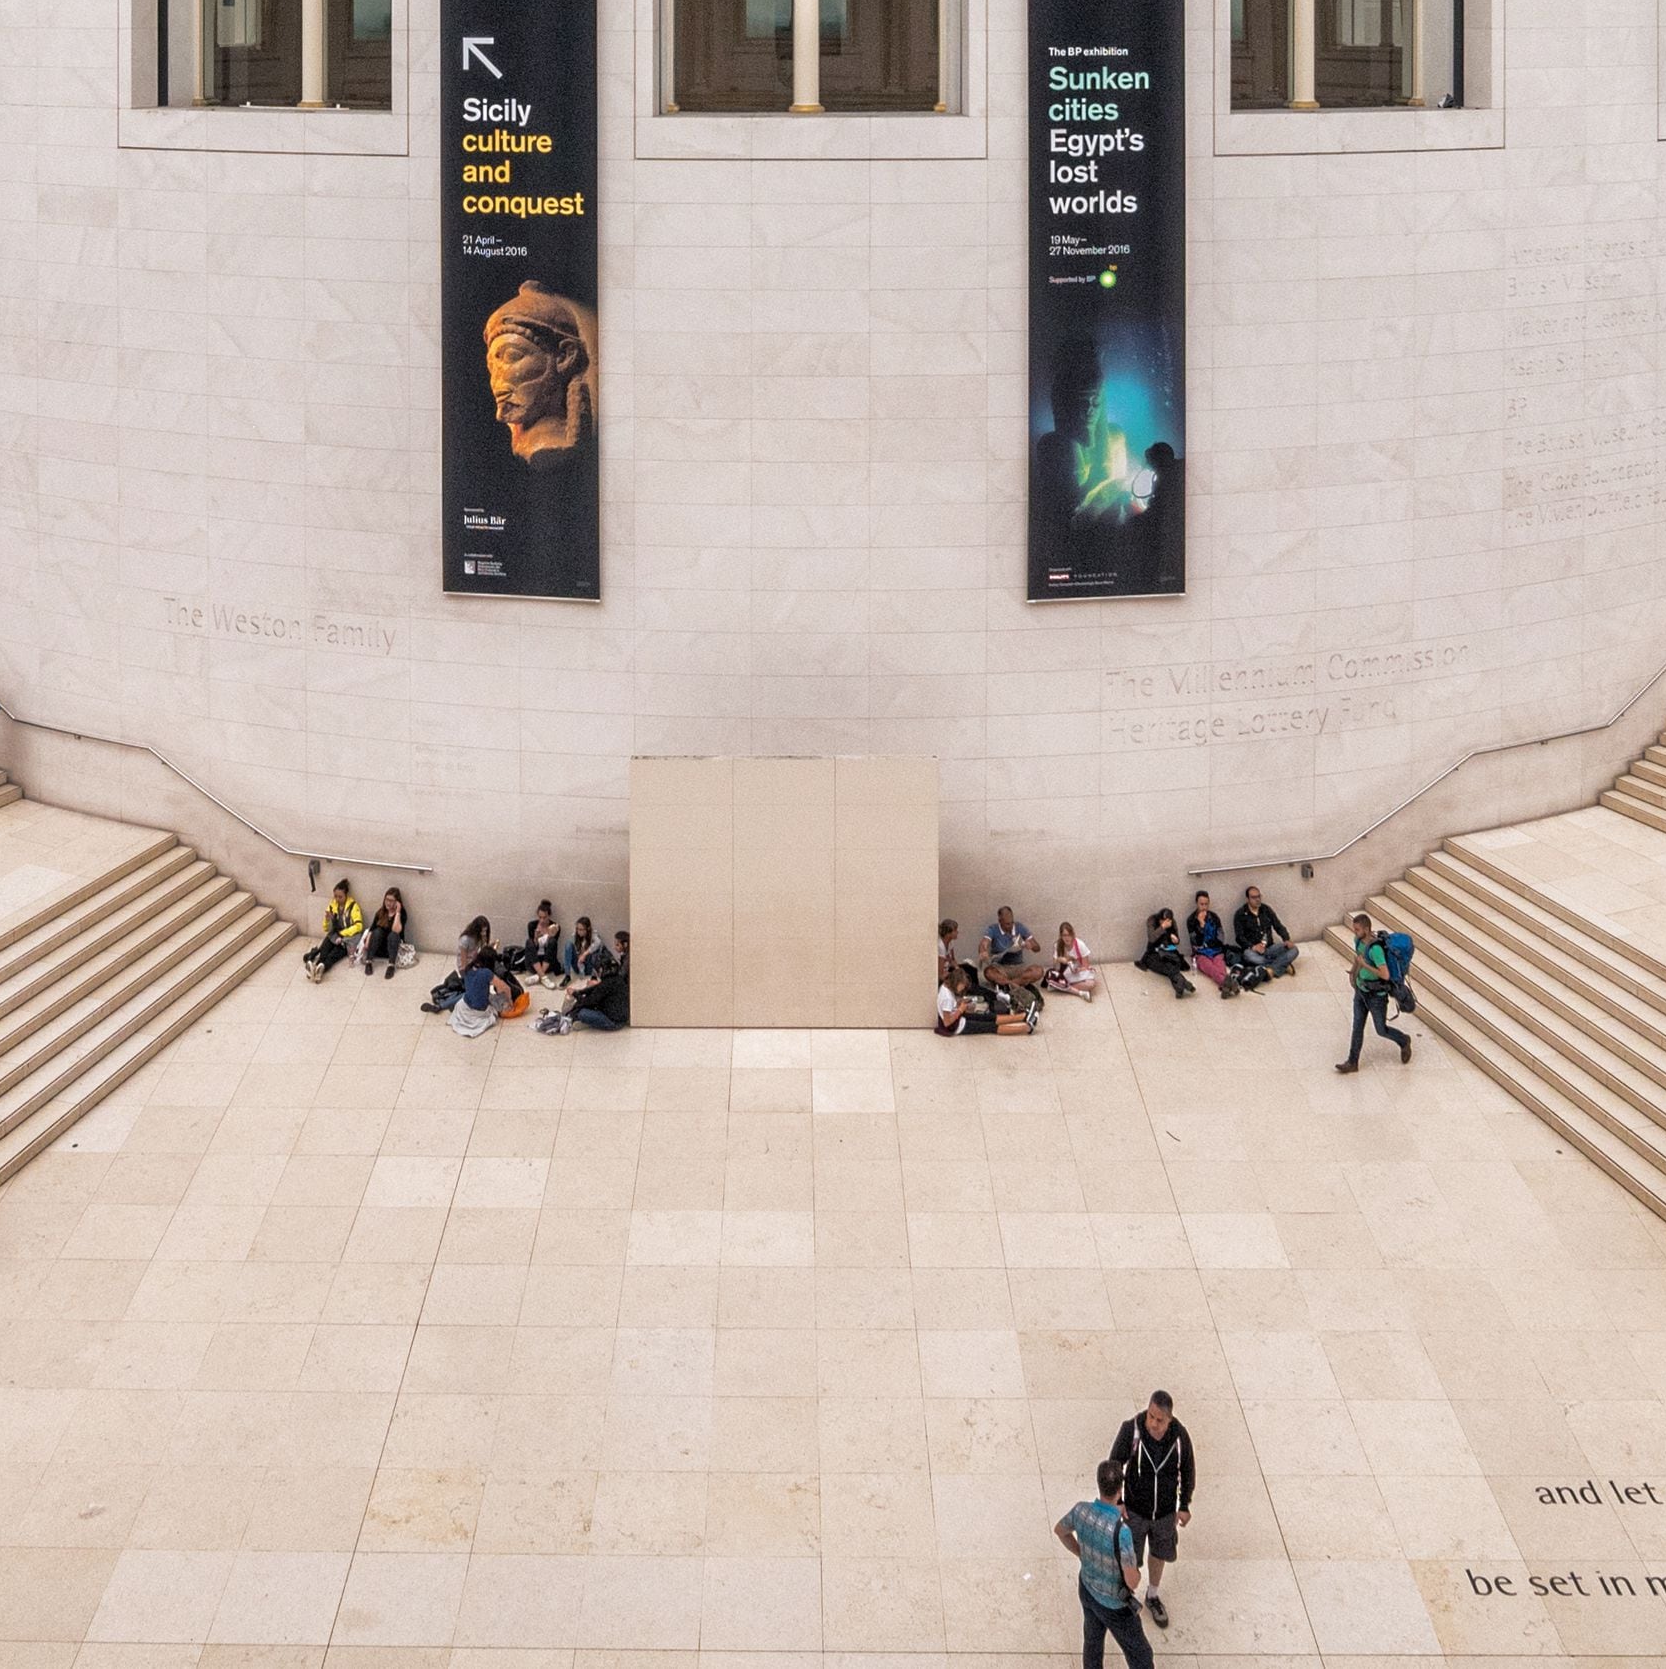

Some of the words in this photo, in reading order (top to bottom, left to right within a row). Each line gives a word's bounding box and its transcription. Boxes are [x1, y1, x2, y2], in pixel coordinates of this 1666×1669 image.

[1048, 47, 1066, 57] The
[1067, 47, 1082, 56] BP
[1083, 47, 1129, 56] exhibition
[1048, 65, 1150, 91] Sunken
[461, 97, 533, 126] Sicily
[1048, 97, 1119, 122] cities
[461, 129, 554, 155] culture
[1048, 127, 1146, 157] Egypt's
[461, 160, 511, 185] and
[1048, 158, 1099, 185] lost
[461, 191, 585, 219] conquest
[1048, 189, 1139, 216] worlds
[462, 234, 473, 244] 21
[475, 235, 495, 247] April
[462, 246, 472, 255] 14
[473, 246, 504, 258] August
[505, 246, 528, 257] 2016
[1049, 246, 1061, 256] 27
[1062, 245, 1106, 256] November
[1108, 244, 1131, 255] 2016
[1050, 235, 1061, 245] 19
[463, 514, 488, 525] Julius
[490, 515, 507, 525] Bär
[162, 595, 205, 630] The
[211, 602, 303, 641] Weston
[311, 613, 399, 656] Family
[1104, 668, 1155, 699] The
[1166, 659, 1316, 696] Millennium
[1326, 642, 1470, 683] Commission
[1108, 712, 1226, 748] Heritage
[1236, 705, 1330, 737] Lottery
[1533, 1477, 1604, 1507] and
[1611, 1478, 1663, 1507] let
[1466, 1567, 1518, 1599] be
[1528, 1571, 1591, 1599] set
[1599, 1570, 1637, 1599] in
